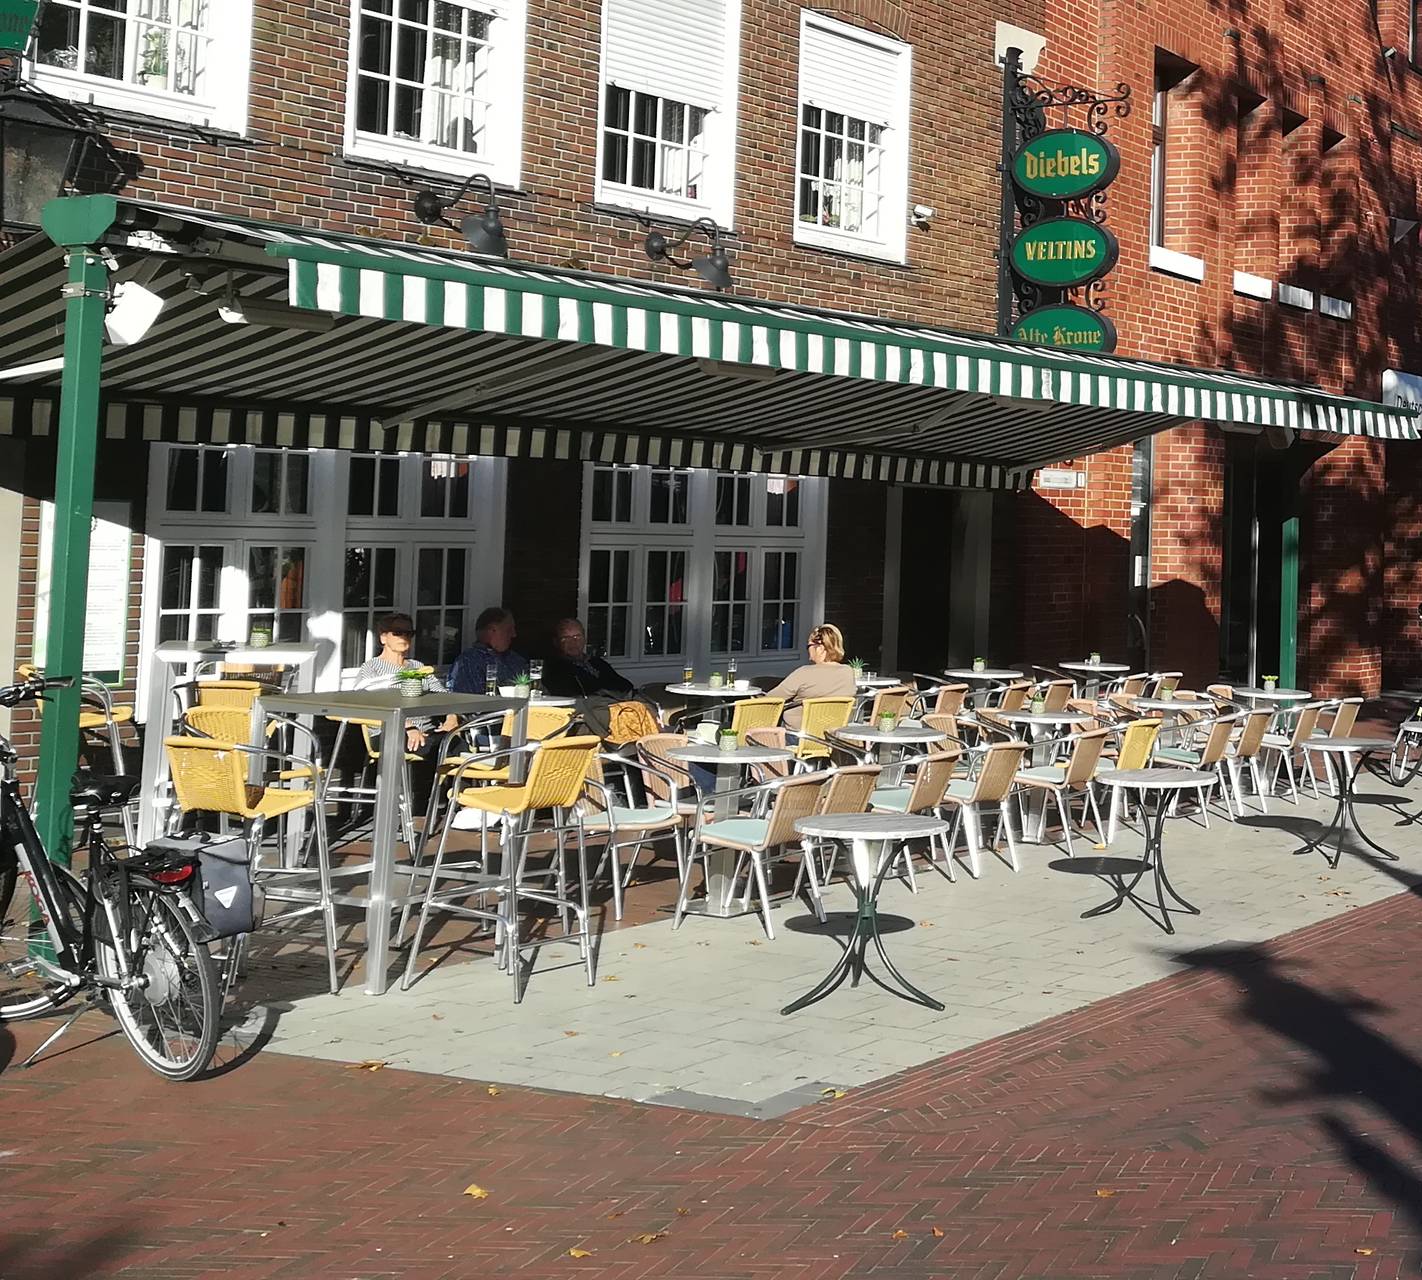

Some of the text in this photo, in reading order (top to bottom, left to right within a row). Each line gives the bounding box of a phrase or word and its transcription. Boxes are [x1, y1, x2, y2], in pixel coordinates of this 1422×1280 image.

[1024, 148, 1099, 179] Diebels
[1025, 240, 1096, 260] VELTINS
[1018, 325, 1101, 345] Alte Krone
